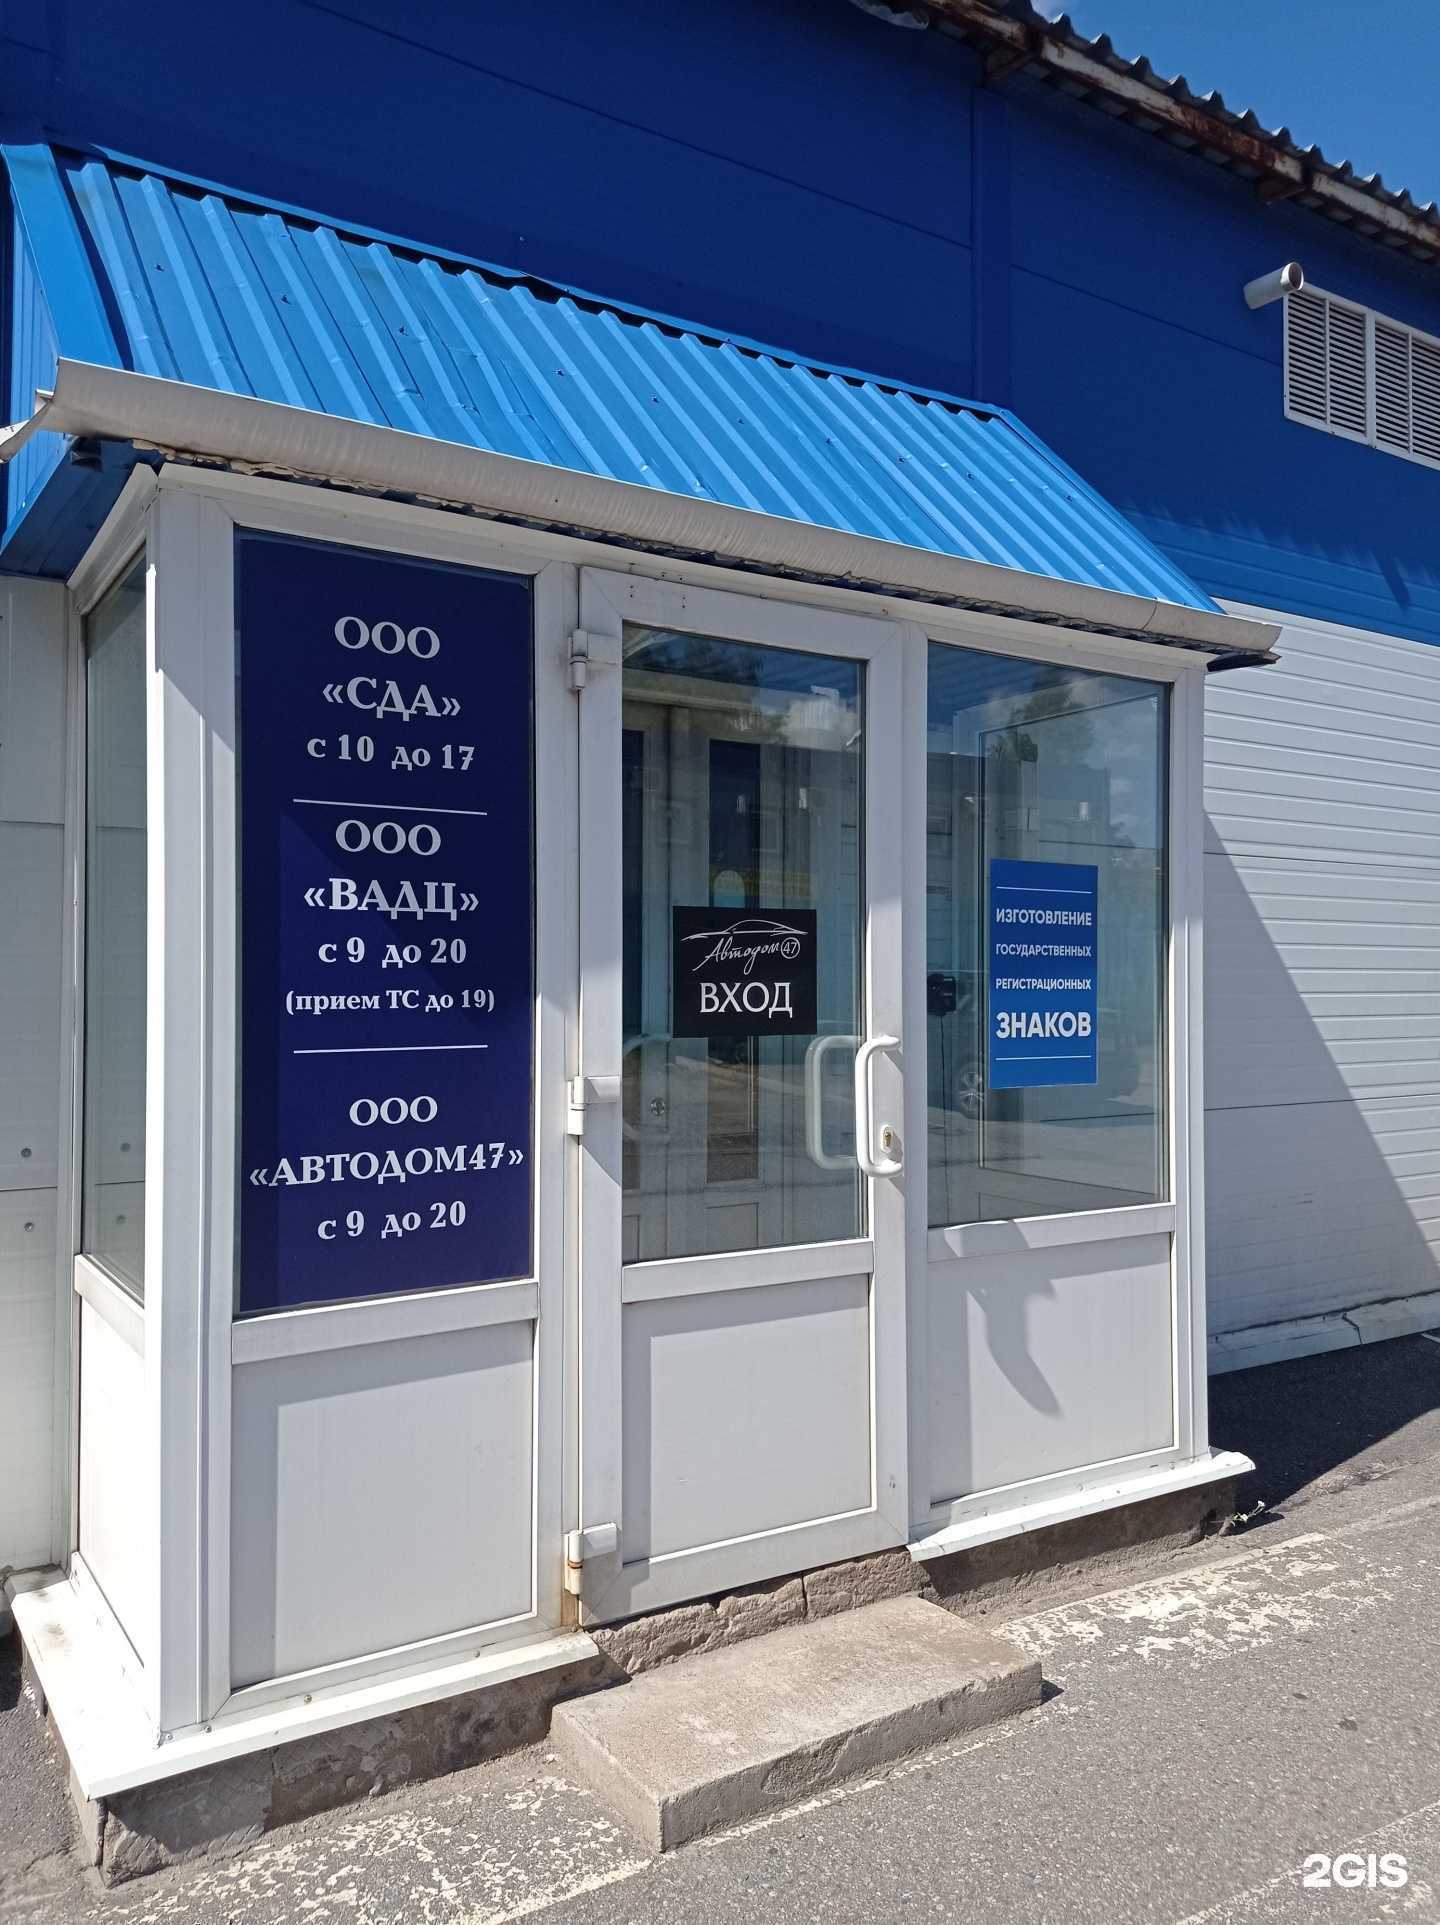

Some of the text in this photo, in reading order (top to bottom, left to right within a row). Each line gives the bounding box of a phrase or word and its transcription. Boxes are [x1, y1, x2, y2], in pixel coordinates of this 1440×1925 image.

[334, 616, 440, 659] ООО
[322, 676, 461, 722] «СДА»
[307, 734, 475, 771] с 10 до 17
[335, 820, 441, 856] ООО
[304, 877, 480, 921] «ВАДЦ»
[996, 908, 1092, 926] ИЗГОТОВЛЕНИЕ
[318, 936, 467, 968] с 9 до 20
[692, 936, 798, 975] Автодом 47
[996, 944, 1092, 957] ГОСУДАРСТВЕННЫХ
[285, 989, 495, 1015] (прием ТС до 19)
[700, 982, 793, 1019] ВХОД
[996, 978, 1092, 991] РЕГИСТРАЦИОННЫХ
[996, 1011, 1092, 1039] ЗНАКОВ
[349, 1095, 438, 1126] ООО
[249, 1142, 524, 1187] «АВТОДОМ47»
[317, 1200, 466, 1240] с 9 до 20
